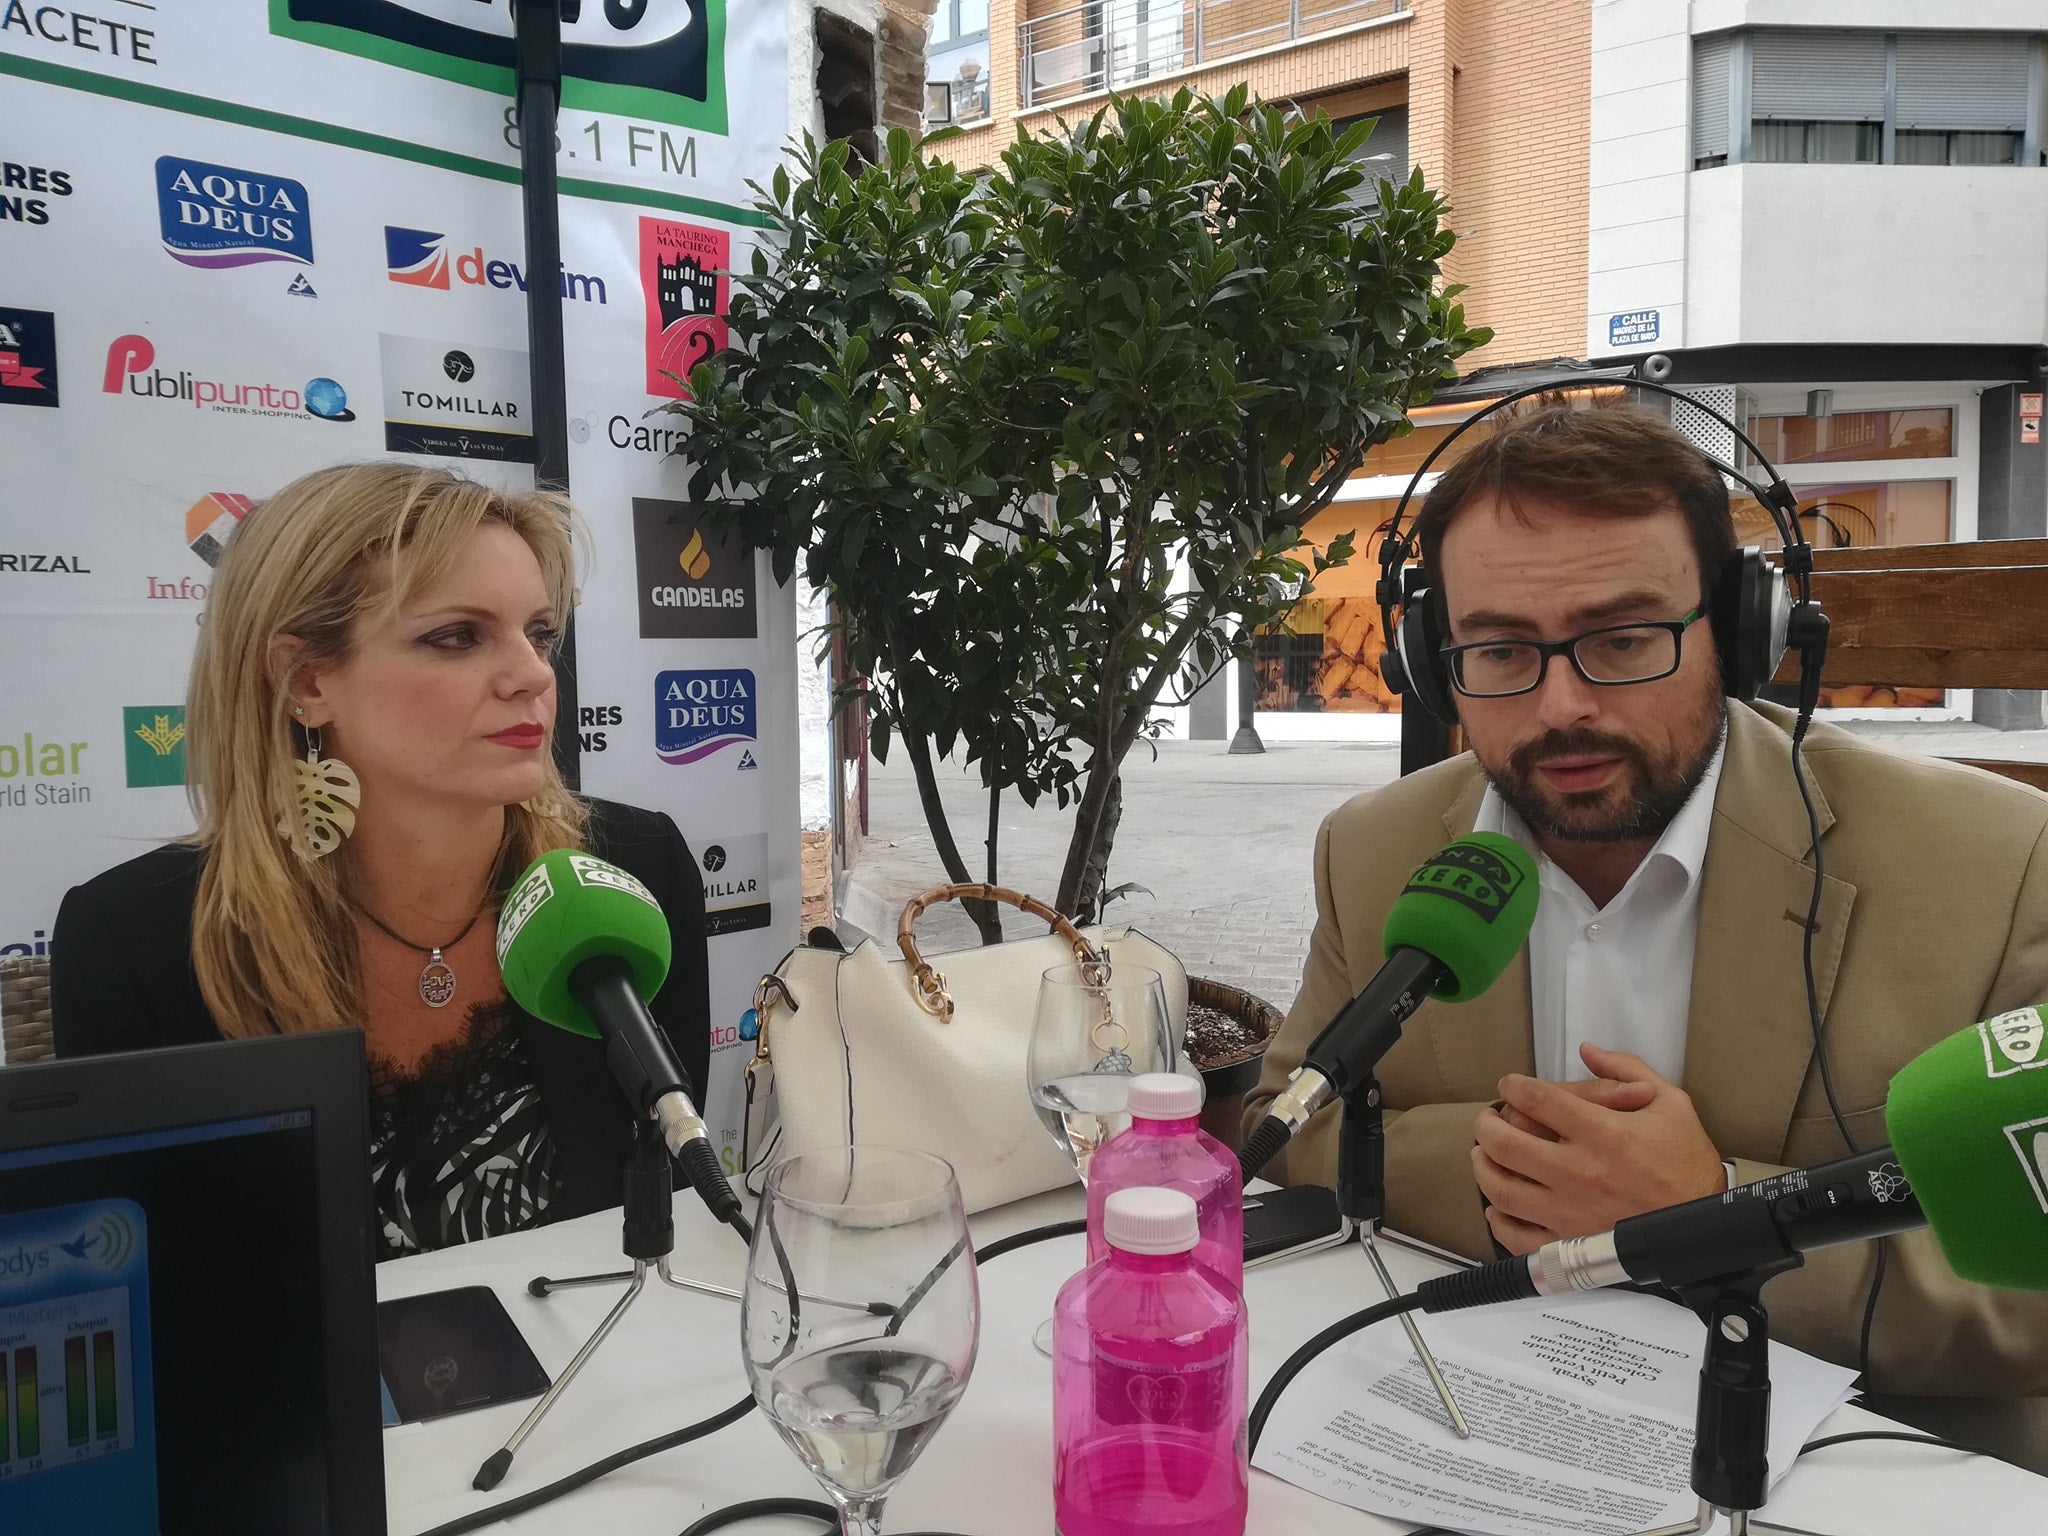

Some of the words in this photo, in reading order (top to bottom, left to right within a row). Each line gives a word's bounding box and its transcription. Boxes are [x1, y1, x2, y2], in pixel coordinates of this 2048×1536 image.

[1, 0, 158, 65] ACETE
[503, 106, 602, 162] 8.1
[627, 125, 698, 178] FM
[170, 169, 299, 213] AQUA
[177, 199, 296, 242] DEUS
[190, 240, 223, 249] Mineral
[223, 238, 255, 248] Natural
[656, 225, 671, 237] LA
[672, 227, 718, 245] TAURINO
[657, 236, 718, 255] MANCHEGA
[456, 247, 607, 305] devim
[1622, 312, 1656, 325] CALLE
[1611, 334, 1630, 345] PLAZA
[1631, 334, 1640, 342] DE
[1640, 332, 1657, 340] MAYO
[1613, 326, 1636, 335] MADRES
[1637, 324, 1646, 333] DE
[102, 334, 300, 411] Publipunto
[212, 405, 312, 420] INTER-SHOPPING
[402, 390, 518, 419] TOMILLAR
[0, 554, 91, 573] RIZAL
[147, 576, 211, 600] Info
[651, 586, 745, 608] CANDELAS
[664, 678, 749, 704] AQUA
[580, 706, 623, 727] RES
[668, 704, 745, 728] DEUS
[578, 731, 607, 752] NS
[35, 782, 91, 806] Stain
[1416, 867, 1491, 899] CERO
[721, 1129, 738, 1144] The
[1826, 1189, 1837, 1205] ON
[1866, 1170, 1889, 1203] AKG
[9, 1301, 78, 1327] Meters
[67, 1316, 108, 1332] Output
[1542, 1314, 1617, 1338] Sauvignon
[1522, 1341, 1578, 1358] Privada
[1530, 1335, 1585, 1352] Privada
[1556, 1333, 1646, 1361] Chardonnay
[1593, 1337, 1620, 1347] MV
[1621, 1336, 1689, 1358] Cabernet
[1536, 1353, 1585, 1372] Verdot
[1583, 1356, 1656, 1381] Colección
[1552, 1367, 1597, 1386] Syrah
[1591, 1368, 1627, 1385] Petit
